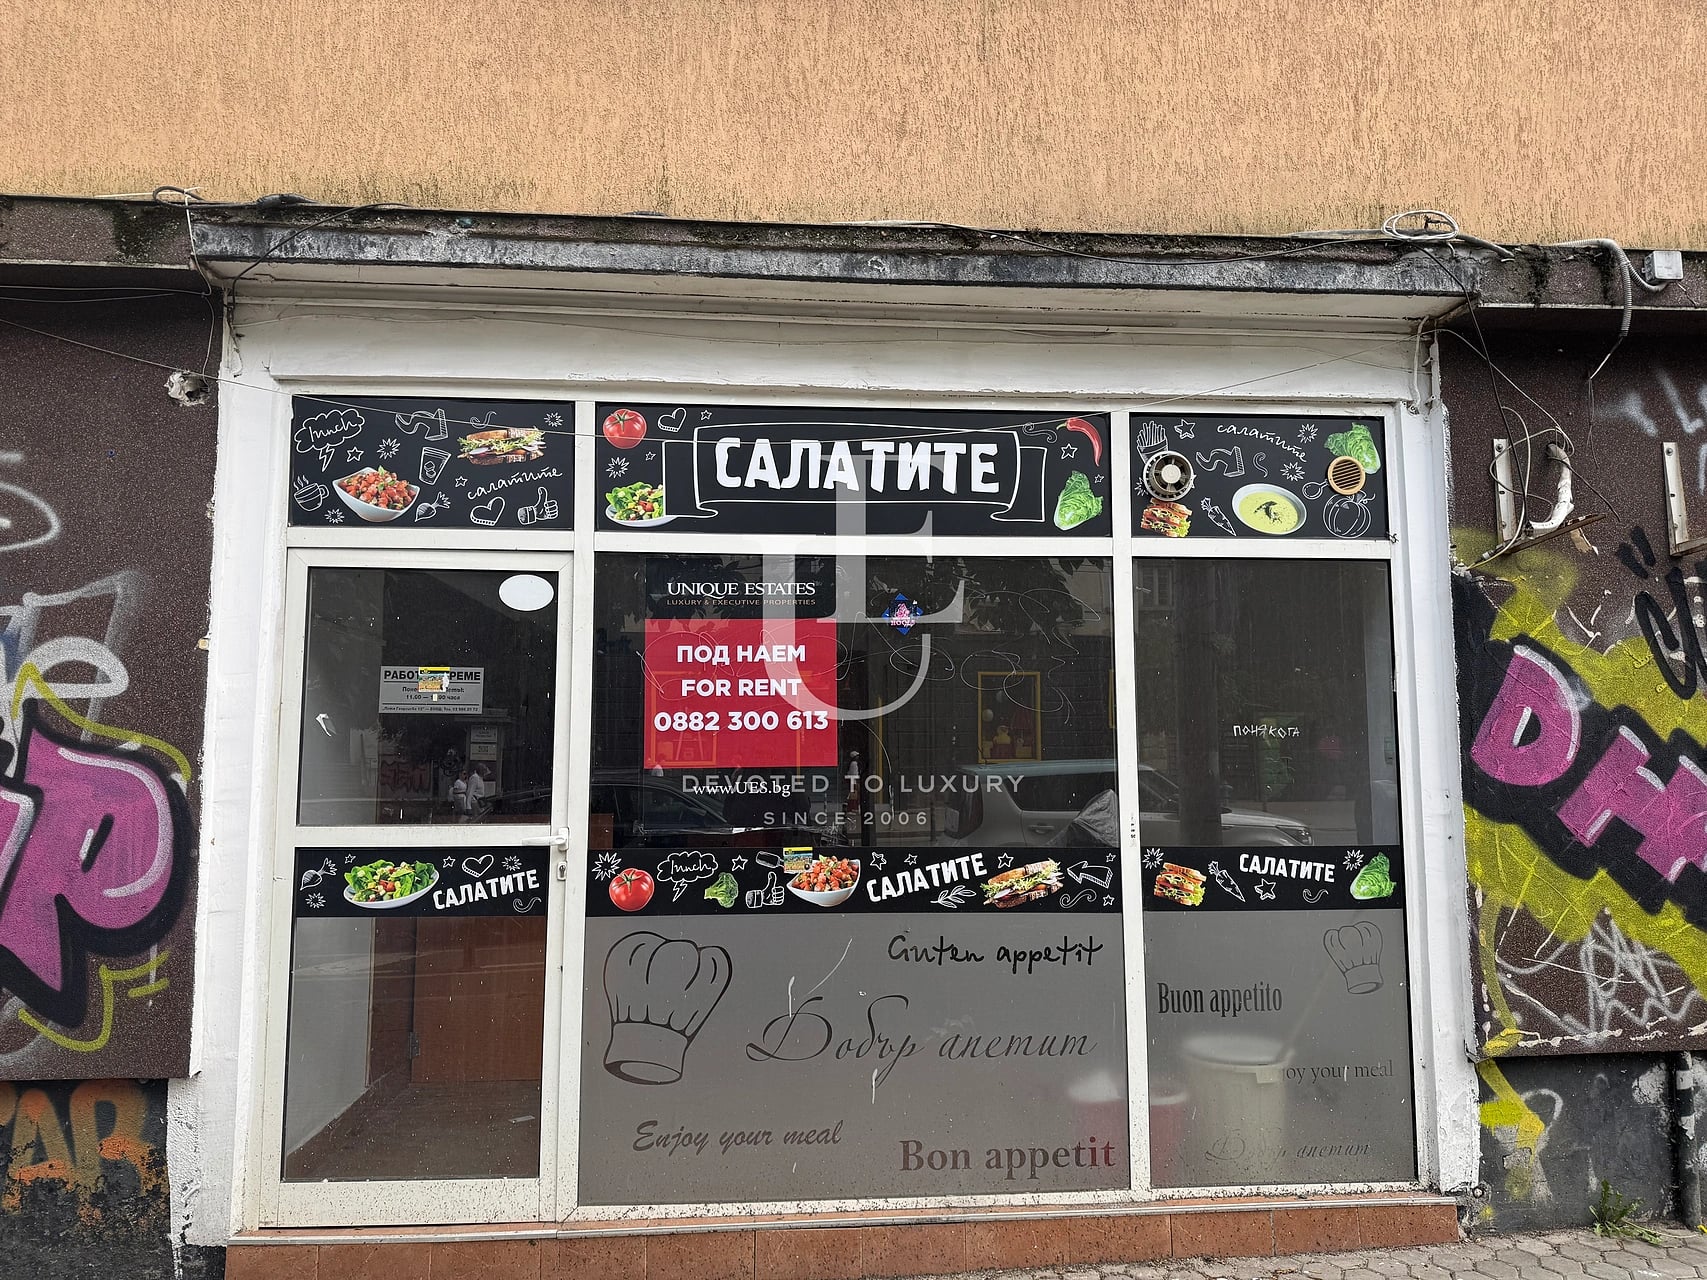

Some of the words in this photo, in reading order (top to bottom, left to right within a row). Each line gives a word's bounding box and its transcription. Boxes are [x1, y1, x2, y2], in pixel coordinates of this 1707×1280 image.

[1217, 424, 1307, 463] салатите
[715, 438, 1000, 494] САЛАТИТЕ
[467, 468, 563, 500] салатите
[667, 582, 739, 599] UNIQUE
[745, 582, 816, 596] ESTATES
[677, 645, 730, 666] ПОД
[737, 645, 806, 663] НАЕМ
[681, 679, 733, 697] FOR
[739, 679, 801, 697] RENT
[653, 711, 720, 732] 0882
[728, 711, 779, 732] 300
[786, 710, 829, 731] 613
[693, 780, 792, 797] www.UES.bg
[670, 859, 712, 873] lunch
[866, 852, 988, 902] САЛАТИТЕ
[1239, 853, 1336, 883] САЛАТИТЕ
[433, 869, 540, 910] САЛАТИТЕ
[888, 934, 985, 966] Guten
[997, 935, 1104, 975] appetit
[1157, 982, 1204, 1014] Buon
[1209, 981, 1283, 1017] appetito
[939, 1032, 1098, 1061] апетит
[1354, 1059, 1394, 1078] meal
[632, 1120, 710, 1157] Enjoy
[719, 1127, 774, 1155] your
[783, 1119, 844, 1146] meal
[899, 1139, 972, 1172] Bon
[985, 1136, 1116, 1180] appetit
